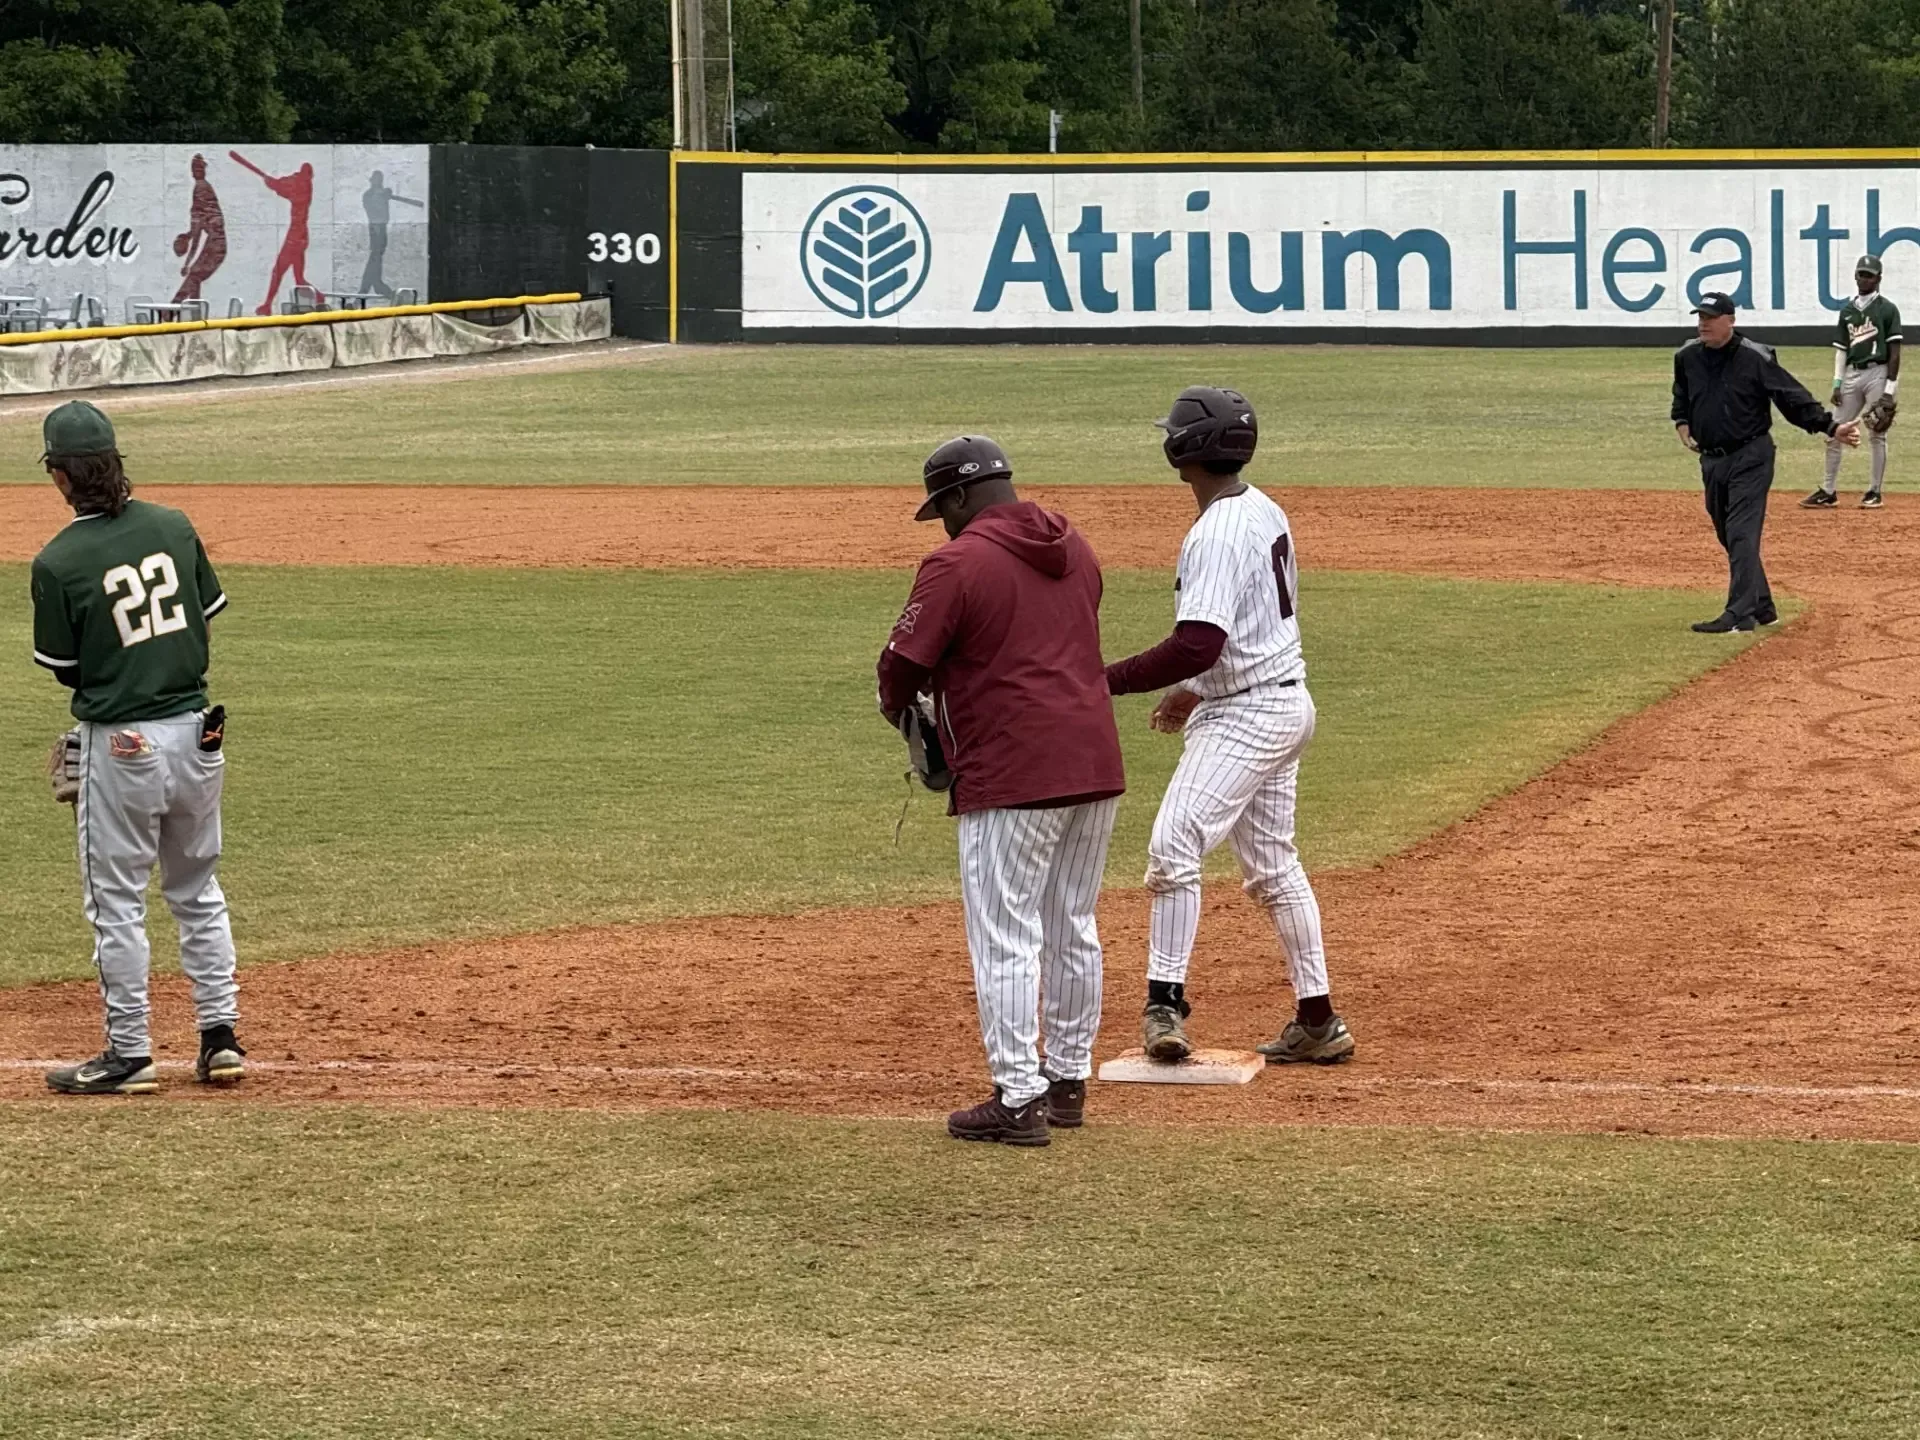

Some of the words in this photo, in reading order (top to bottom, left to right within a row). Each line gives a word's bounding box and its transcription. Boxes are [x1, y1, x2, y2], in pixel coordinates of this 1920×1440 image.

[0, 171, 139, 261] rden
[587, 232, 661, 264] 330
[973, 190, 1453, 313] Atrium
[1503, 188, 1920, 313] Health
[103, 552, 188, 648] 22
